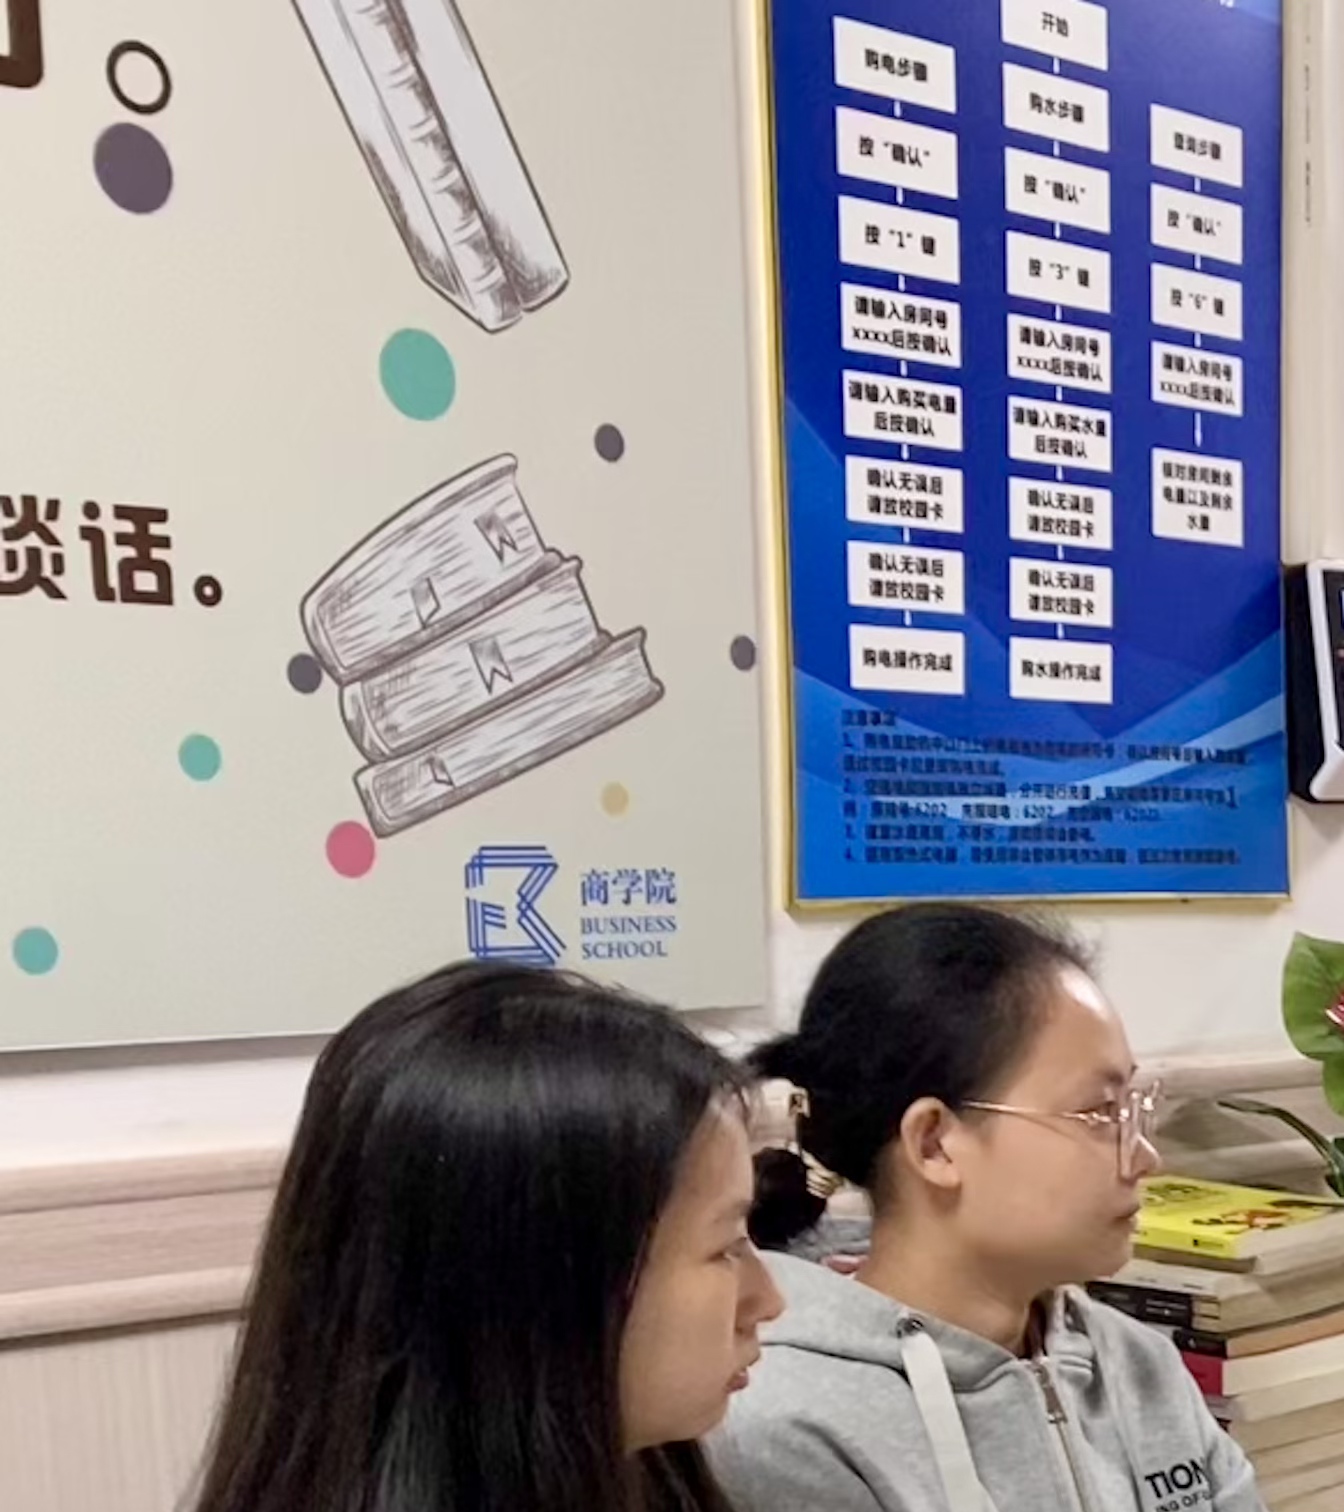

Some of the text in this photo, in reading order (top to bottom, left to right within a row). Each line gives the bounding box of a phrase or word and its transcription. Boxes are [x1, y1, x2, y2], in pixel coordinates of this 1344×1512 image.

[864, 48, 928, 82] 购电步骤
[1029, 92, 1085, 124] 购水步骤
[853, 297, 948, 330] 请输入房间号
[848, 381, 957, 416] 请输入购买电量
[874, 412, 935, 437] 后按确认
[1013, 407, 1107, 437] 请输入购买水量
[867, 468, 943, 495] 确认无误后
[1028, 489, 1095, 515] 确认无误后
[869, 552, 944, 578] 确认无误后
[1028, 569, 1095, 593] 确认无误后
[862, 649, 953, 673] 购电操作完成
[1021, 660, 1102, 683] 购水操作完成
[580, 867, 676, 906] 商学院
[581, 915, 677, 935] BUSINESS
[582, 940, 668, 960] SCHOOL
